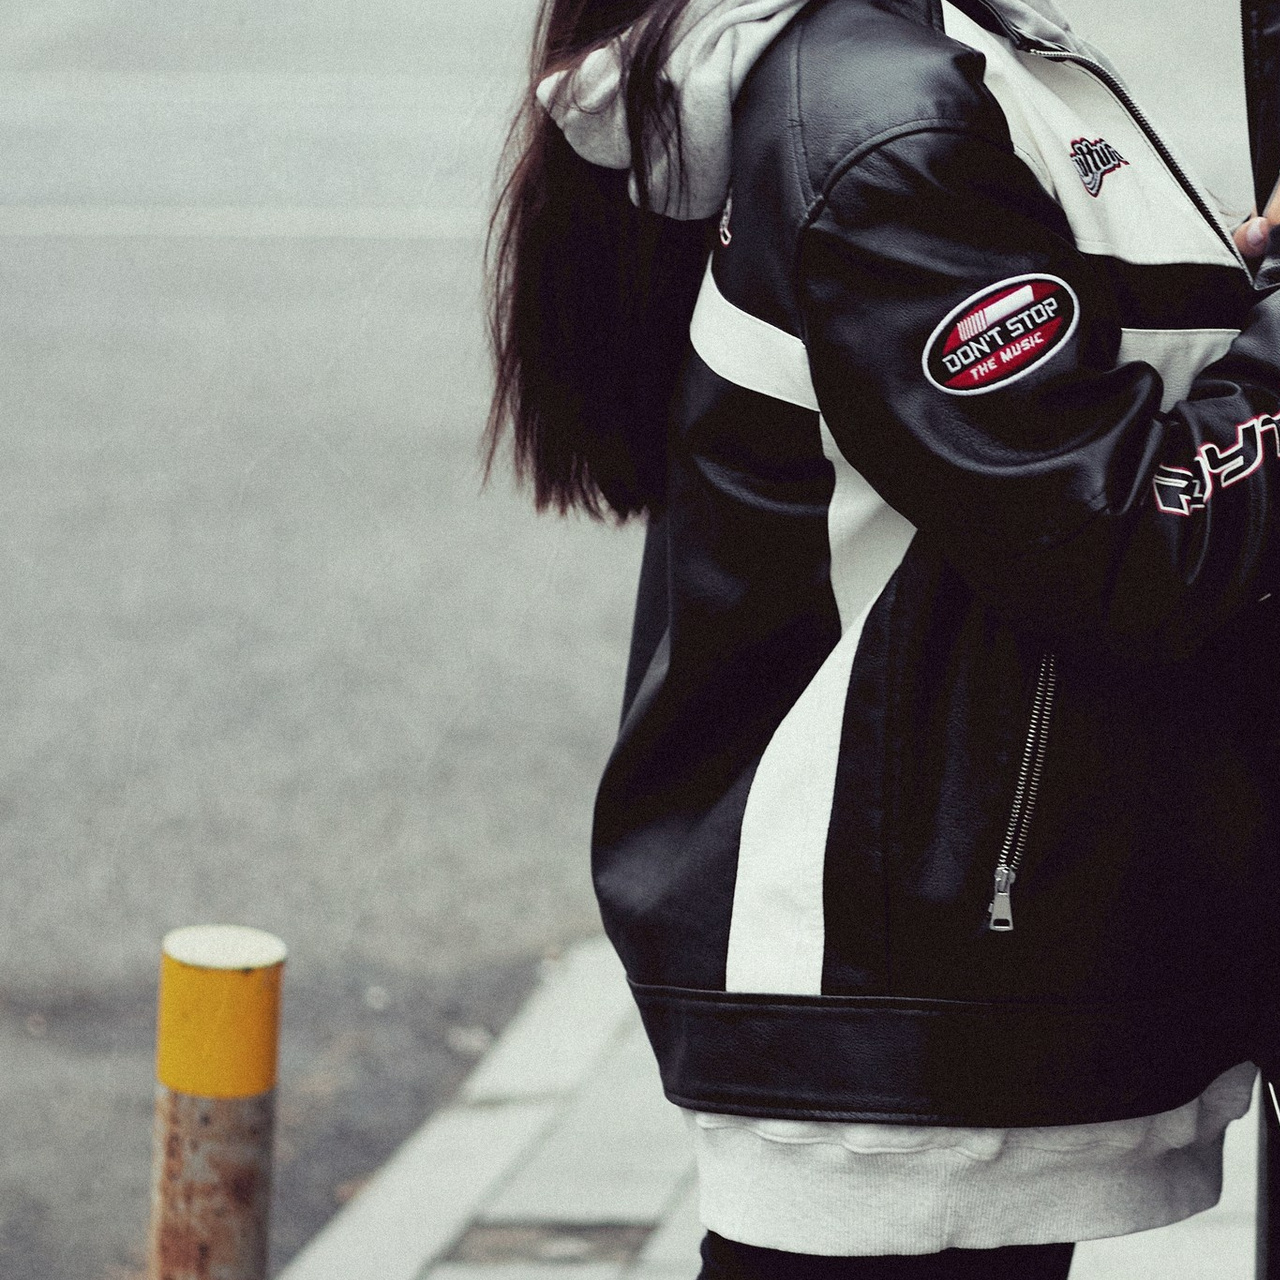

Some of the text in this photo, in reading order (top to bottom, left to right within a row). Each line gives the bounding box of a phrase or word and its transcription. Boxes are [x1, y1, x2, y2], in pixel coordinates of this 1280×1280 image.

[942, 297, 1059, 373] DON'T STOP
[969, 332, 1044, 381] THE MUSIC
